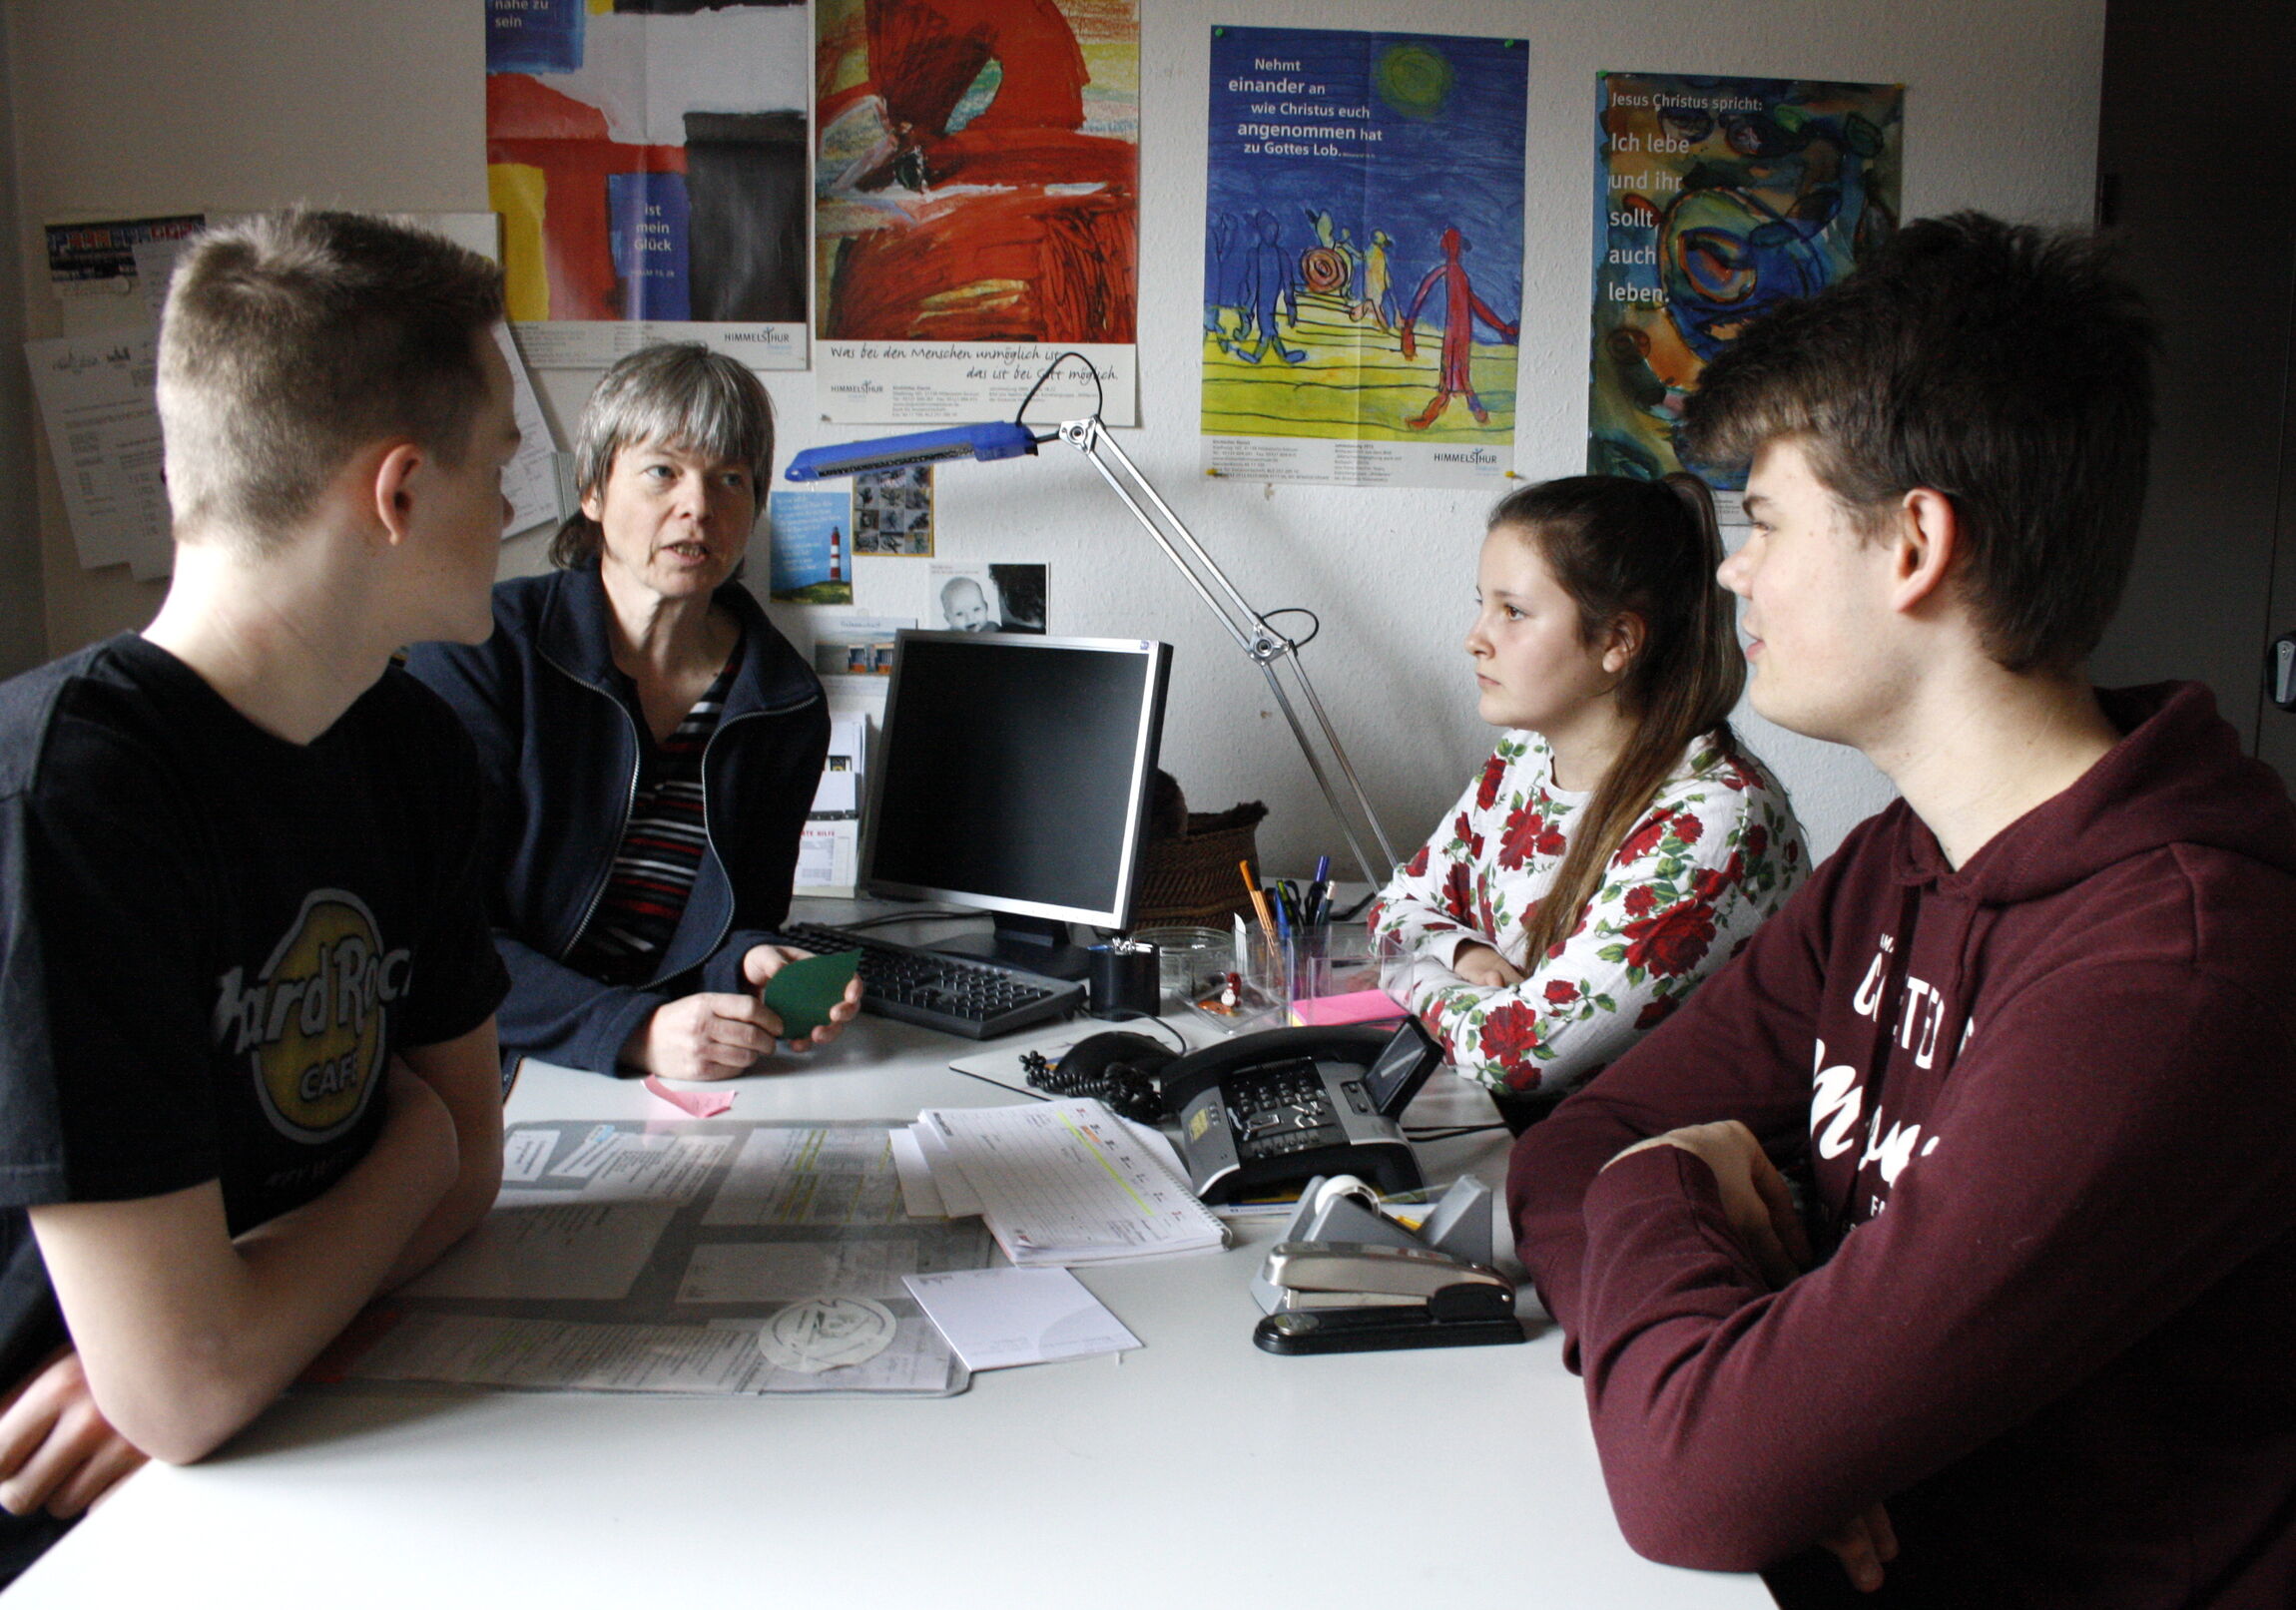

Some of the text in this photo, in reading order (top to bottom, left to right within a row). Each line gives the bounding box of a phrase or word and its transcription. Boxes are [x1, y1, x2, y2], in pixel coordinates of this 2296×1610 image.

[533, 0, 548, 10] zu
[495, 15, 522, 28] sein
[1255, 58, 1301, 72] Nehmt
[1229, 76, 1326, 95] einander an
[1251, 102, 1370, 119] wie Christus euch
[1612, 92, 1763, 112] Jesus Christus spricht:
[1238, 123, 1383, 141] angenommen hat
[1244, 144, 1260, 154] zu
[1264, 142, 1309, 156] Gottes
[1314, 144, 1342, 157] Lob.
[1611, 133, 1690, 154] Ich lebe
[1610, 171, 1683, 192] und ihr
[644, 204, 661, 216] ist
[1610, 208, 1653, 228] sollt
[636, 221, 670, 234] mein
[634, 238, 672, 251] Glück
[1609, 246, 1656, 265] auch
[1608, 282, 1669, 302] leben.
[831, 346, 855, 359] Was
[861, 343, 877, 358] bei
[883, 345, 906, 358] den
[911, 343, 971, 359] Menschen
[976, 344, 1039, 365] unmöglich
[966, 367, 986, 379] das
[992, 366, 1009, 379] ist
[1013, 364, 1032, 379] bei
[1037, 367, 1065, 380] Gtt
